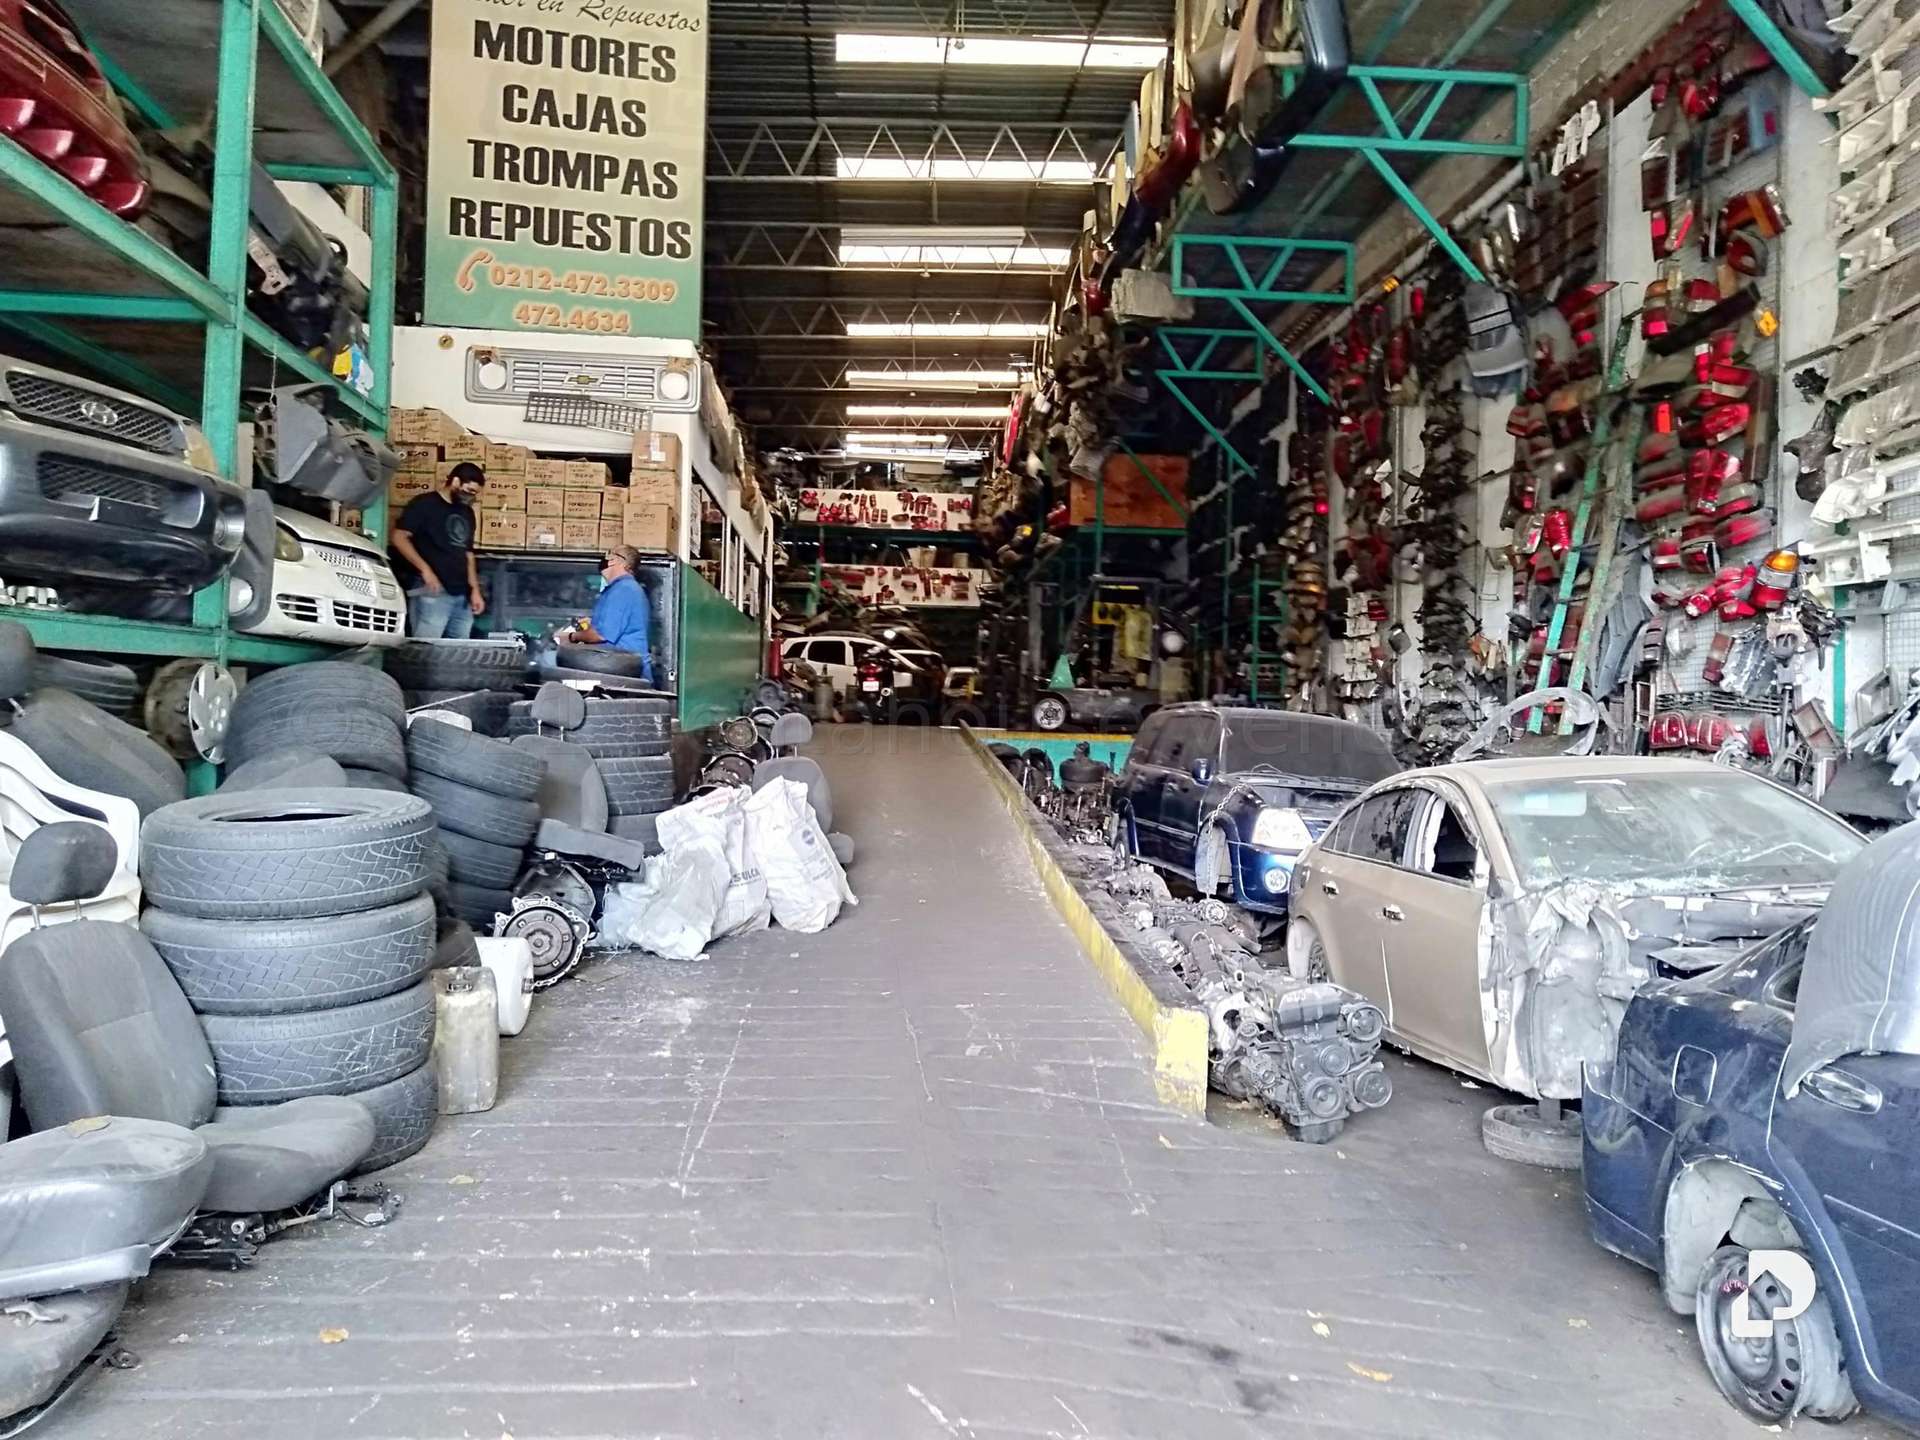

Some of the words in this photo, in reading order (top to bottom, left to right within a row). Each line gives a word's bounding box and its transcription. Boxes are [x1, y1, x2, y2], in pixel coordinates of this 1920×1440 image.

[576, 0, 701, 32] Repuestos
[473, 19, 677, 83] MOTORES
[501, 83, 647, 138] CAJAS
[466, 138, 678, 200] TROMPAS
[448, 196, 692, 260] REPUESTOS
[490, 263, 676, 303] 0212-472.3309
[514, 303, 630, 334] 472.4634
